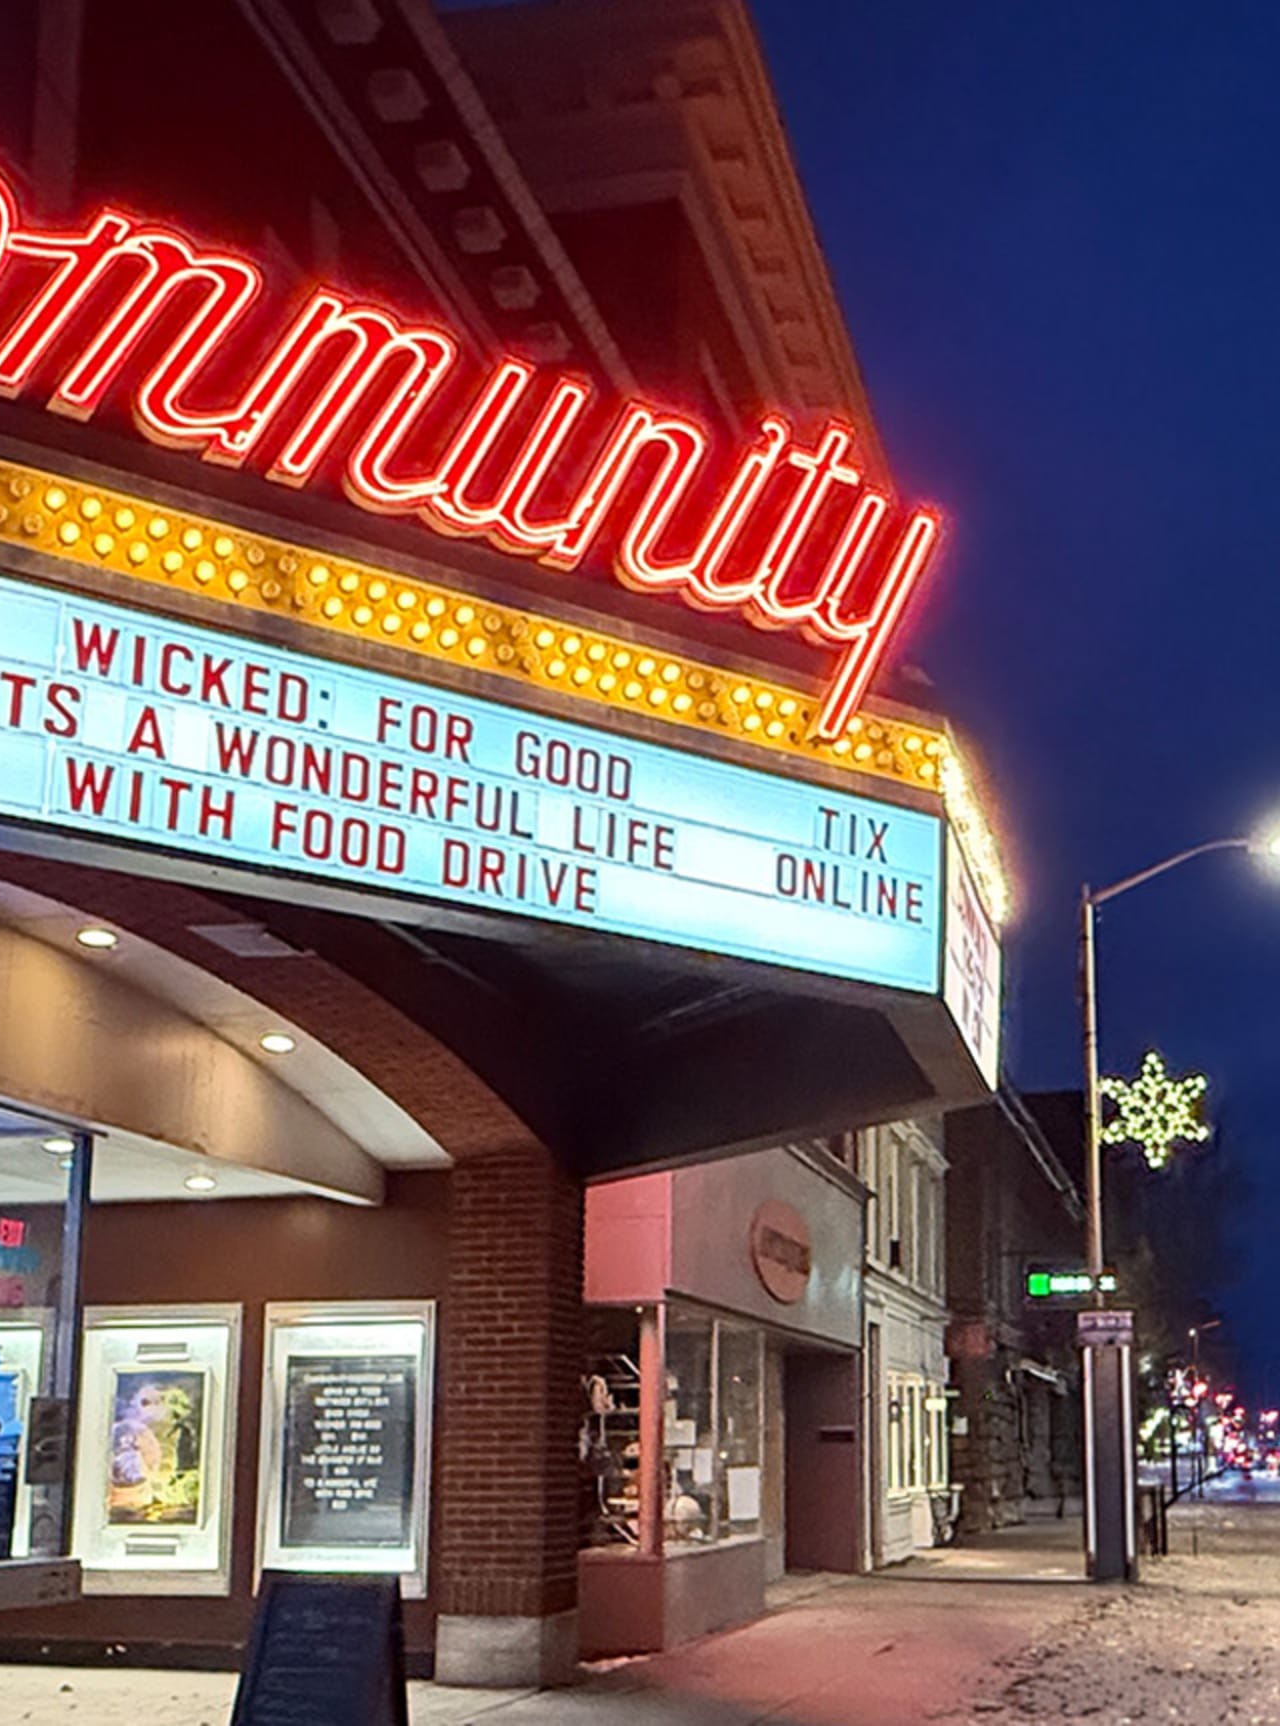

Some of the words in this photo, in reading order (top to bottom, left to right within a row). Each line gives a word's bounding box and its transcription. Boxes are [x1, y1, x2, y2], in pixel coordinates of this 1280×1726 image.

[72, 619, 332, 730] WICKED:
[376, 697, 473, 766] FOR
[515, 731, 633, 803] GOOD
[127, 705, 166, 761] A
[216, 722, 534, 841] WONDERFUL
[572, 805, 676, 871] LIFE
[66, 757, 234, 842] WITH
[271, 803, 407, 876] FOOD
[442, 840, 599, 914] DRIVE
[775, 853, 924, 924] ONLINE
[818, 807, 890, 863] TIX
